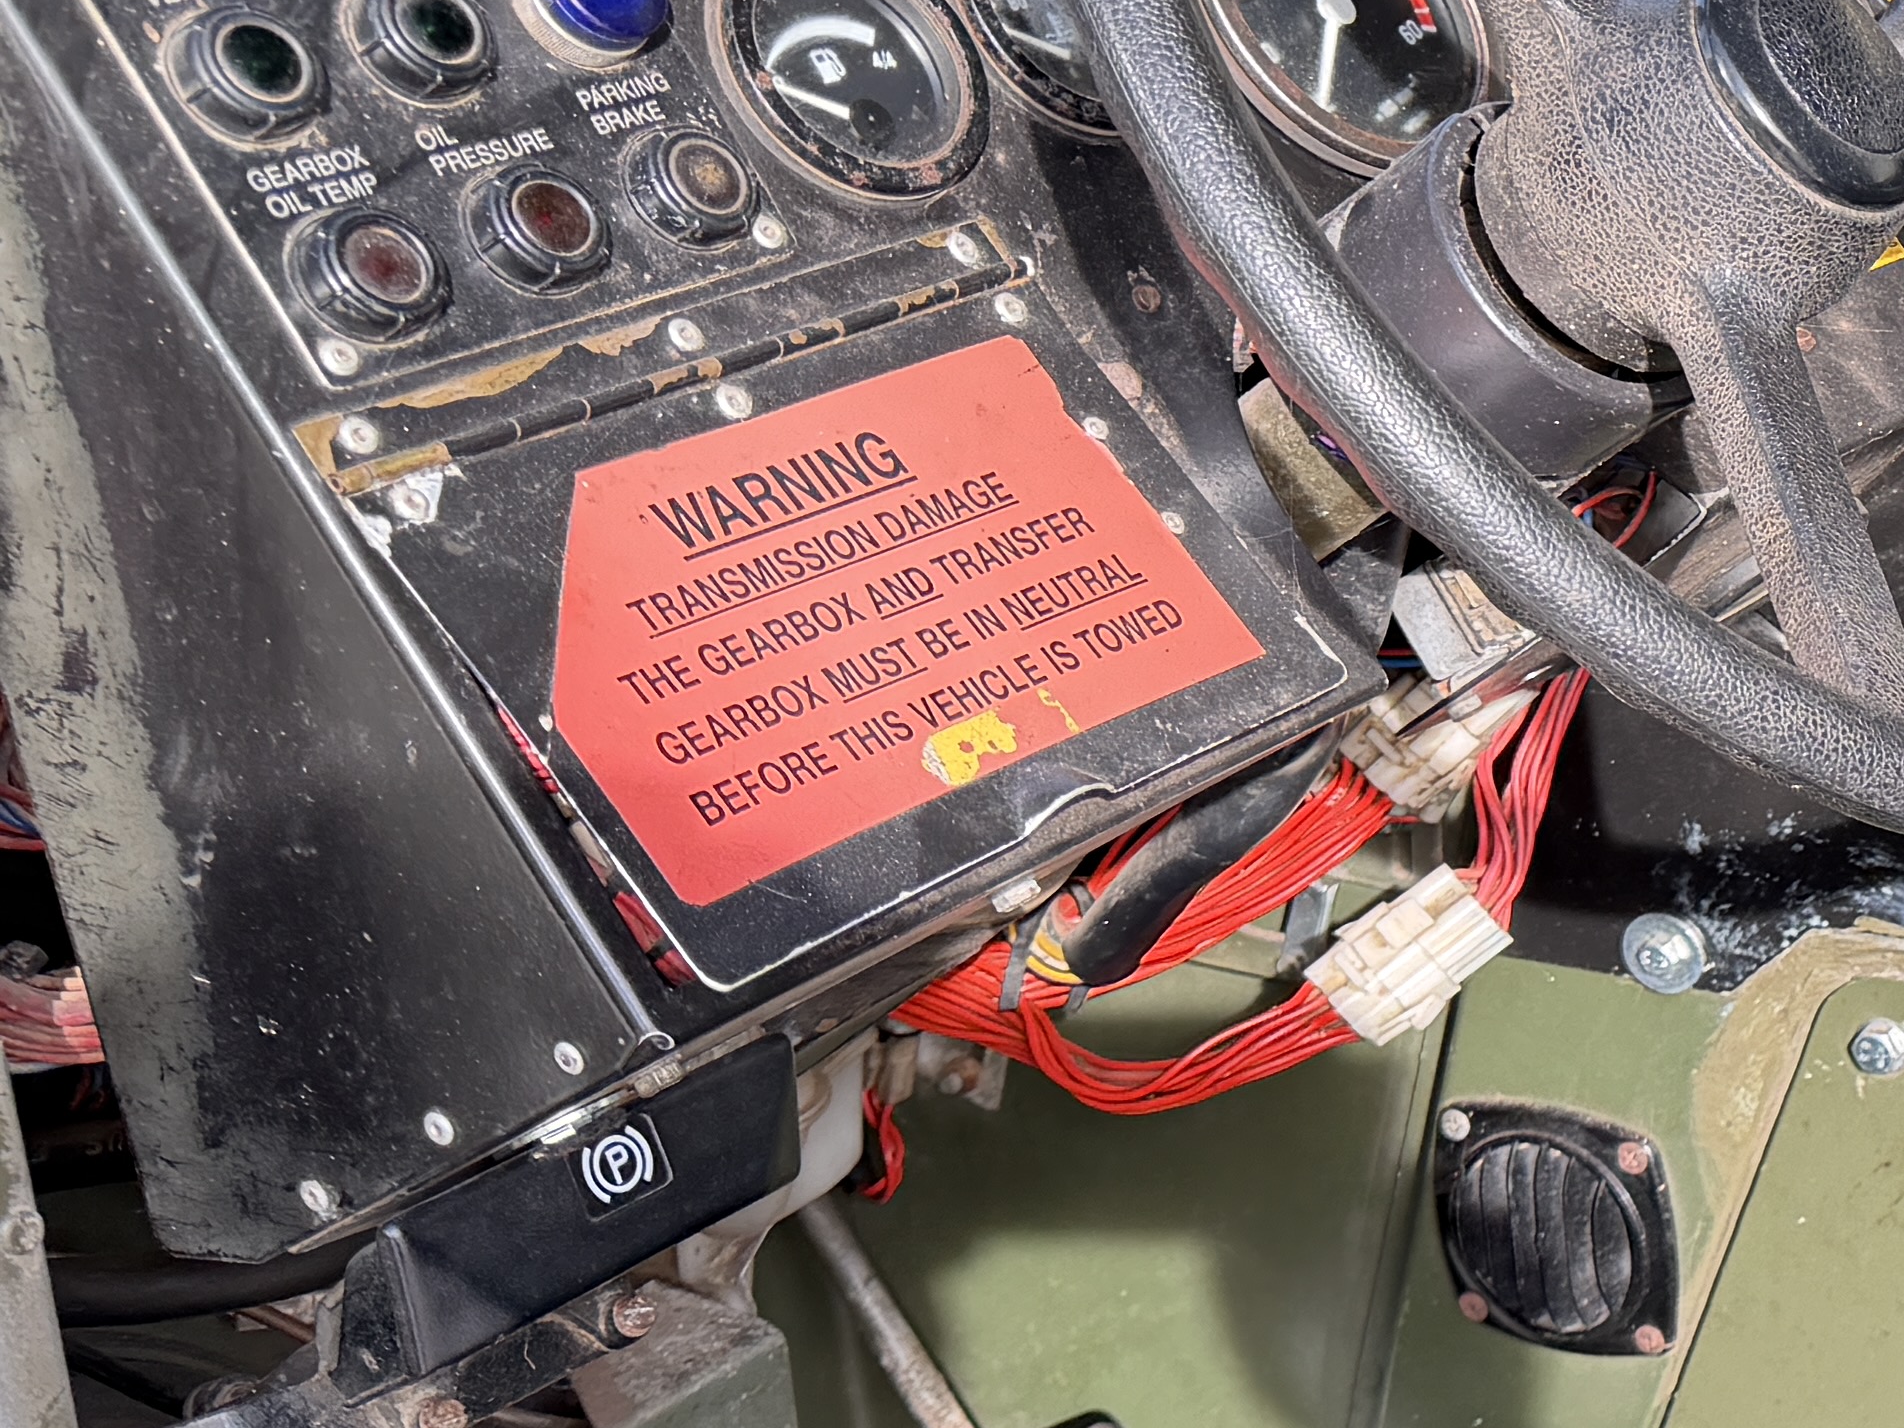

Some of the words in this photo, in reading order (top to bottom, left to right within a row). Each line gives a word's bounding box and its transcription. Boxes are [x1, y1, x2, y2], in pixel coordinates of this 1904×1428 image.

[1398, 20, 1424, 45] 60
[575, 72, 673, 111] PARKING
[414, 125, 459, 151] OIL
[590, 99, 667, 135] BRAKE
[246, 144, 370, 192] GEARBOX
[428, 127, 555, 177] PRESSURE
[265, 189, 313, 218] OIL
[307, 172, 378, 207] TEMP
[648, 432, 909, 549] WARNING
[626, 521, 881, 631] TRANSMISSION
[874, 472, 1013, 542] DAMAGE
[617, 655, 702, 705] THE
[698, 593, 867, 676] GEARBOX
[865, 568, 935, 615] AND
[929, 508, 1095, 585] TRANSFER
[656, 676, 829, 764] GEARBOX
[821, 638, 917, 698] MUST
[915, 619, 971, 659] BE
[963, 604, 1008, 640] IN
[1000, 555, 1143, 626] NEUTRAL
[689, 742, 839, 827] BEFORE
[829, 711, 914, 761] THIS
[907, 654, 1049, 729] VEHICLE
[1041, 641, 1081, 675] IS
[1073, 600, 1183, 659] TOWED
